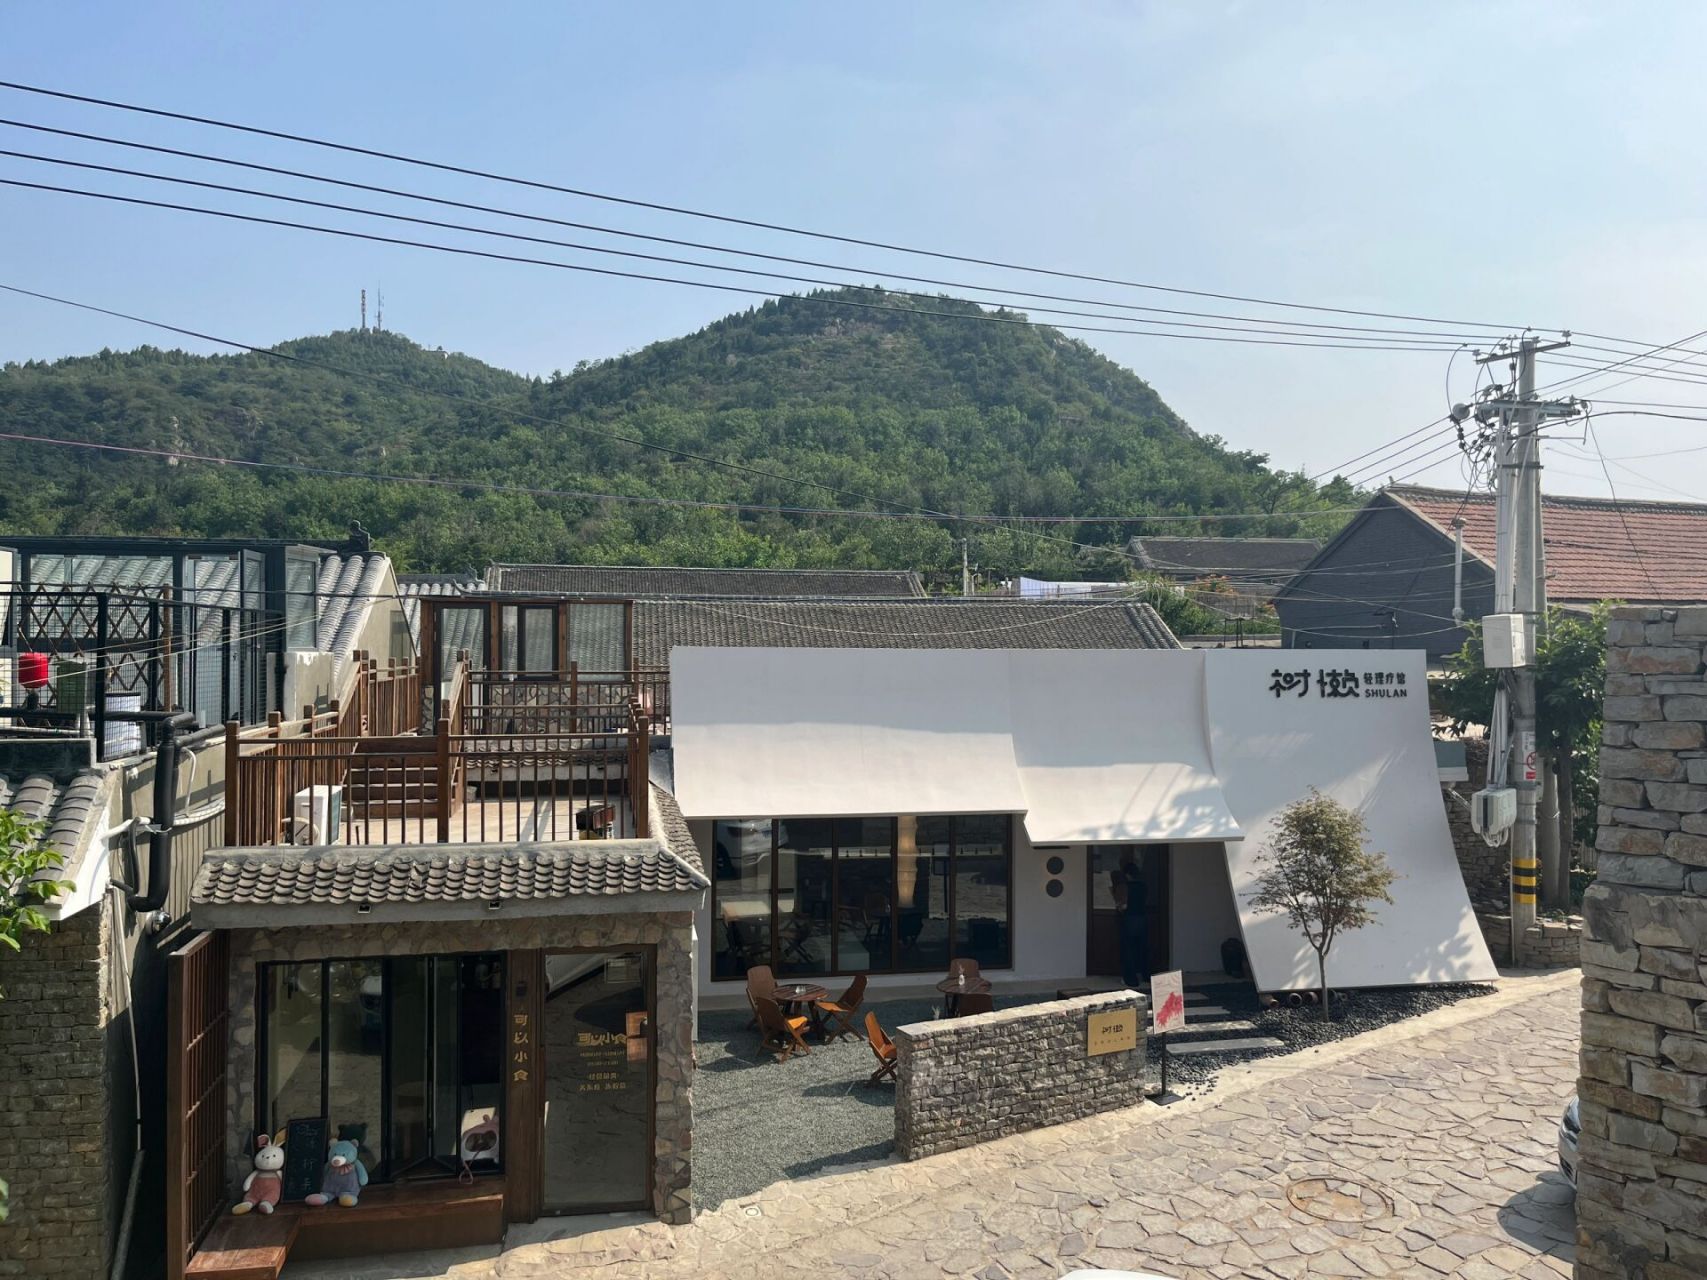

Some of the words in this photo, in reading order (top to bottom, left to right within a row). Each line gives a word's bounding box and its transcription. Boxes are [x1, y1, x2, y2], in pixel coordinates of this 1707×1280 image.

[1364, 688, 1407, 698] SHULAN
[513, 1014, 529, 1082] 可以小食
